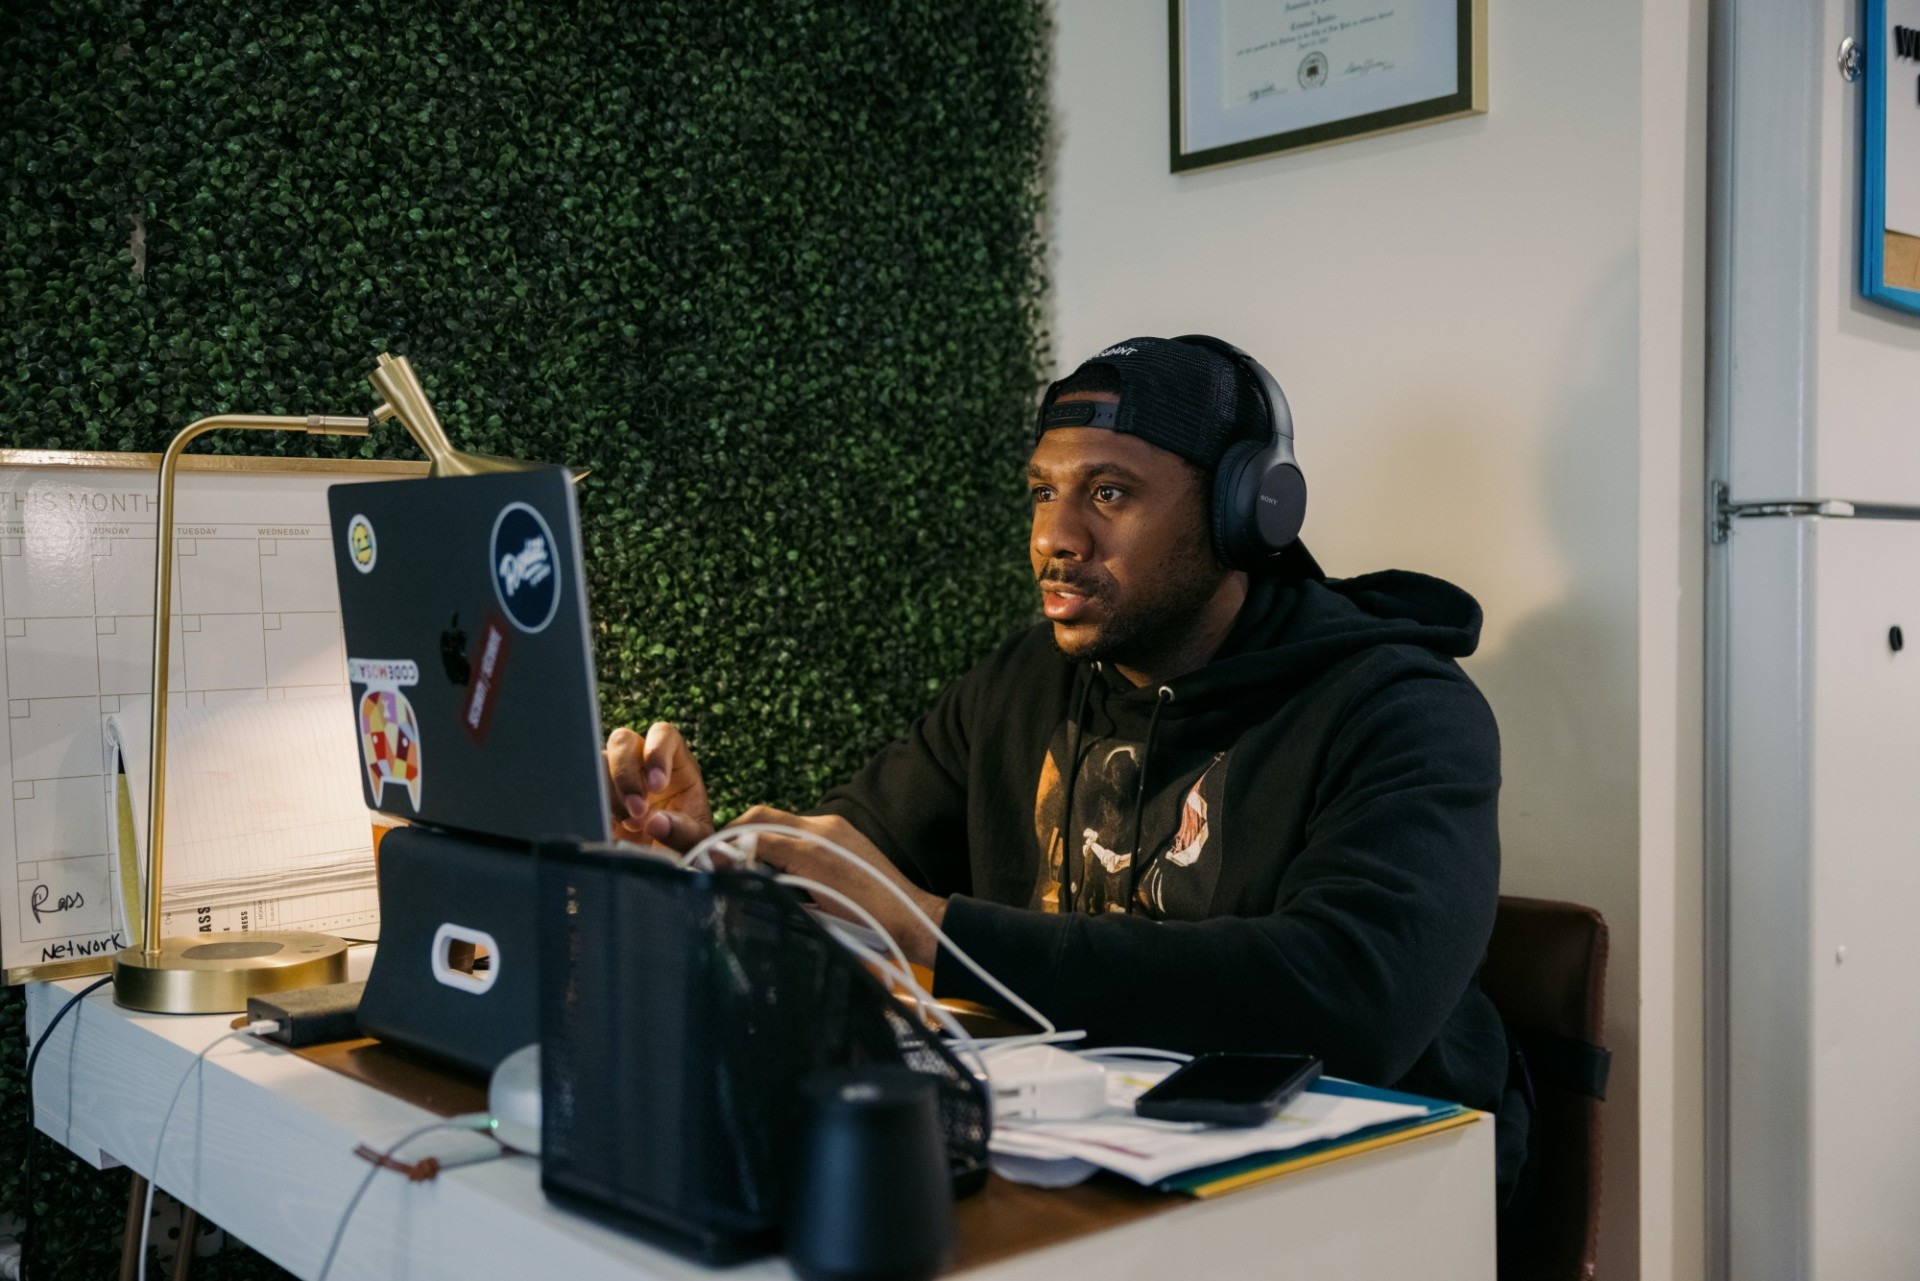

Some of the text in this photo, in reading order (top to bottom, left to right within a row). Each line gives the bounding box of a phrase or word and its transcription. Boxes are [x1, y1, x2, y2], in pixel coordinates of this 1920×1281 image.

[69, 493, 158, 512] MONTH
[1260, 495, 1278, 505] SONY
[177, 527, 217, 535] TUESDAY
[258, 528, 310, 536] WEDNESDAY
